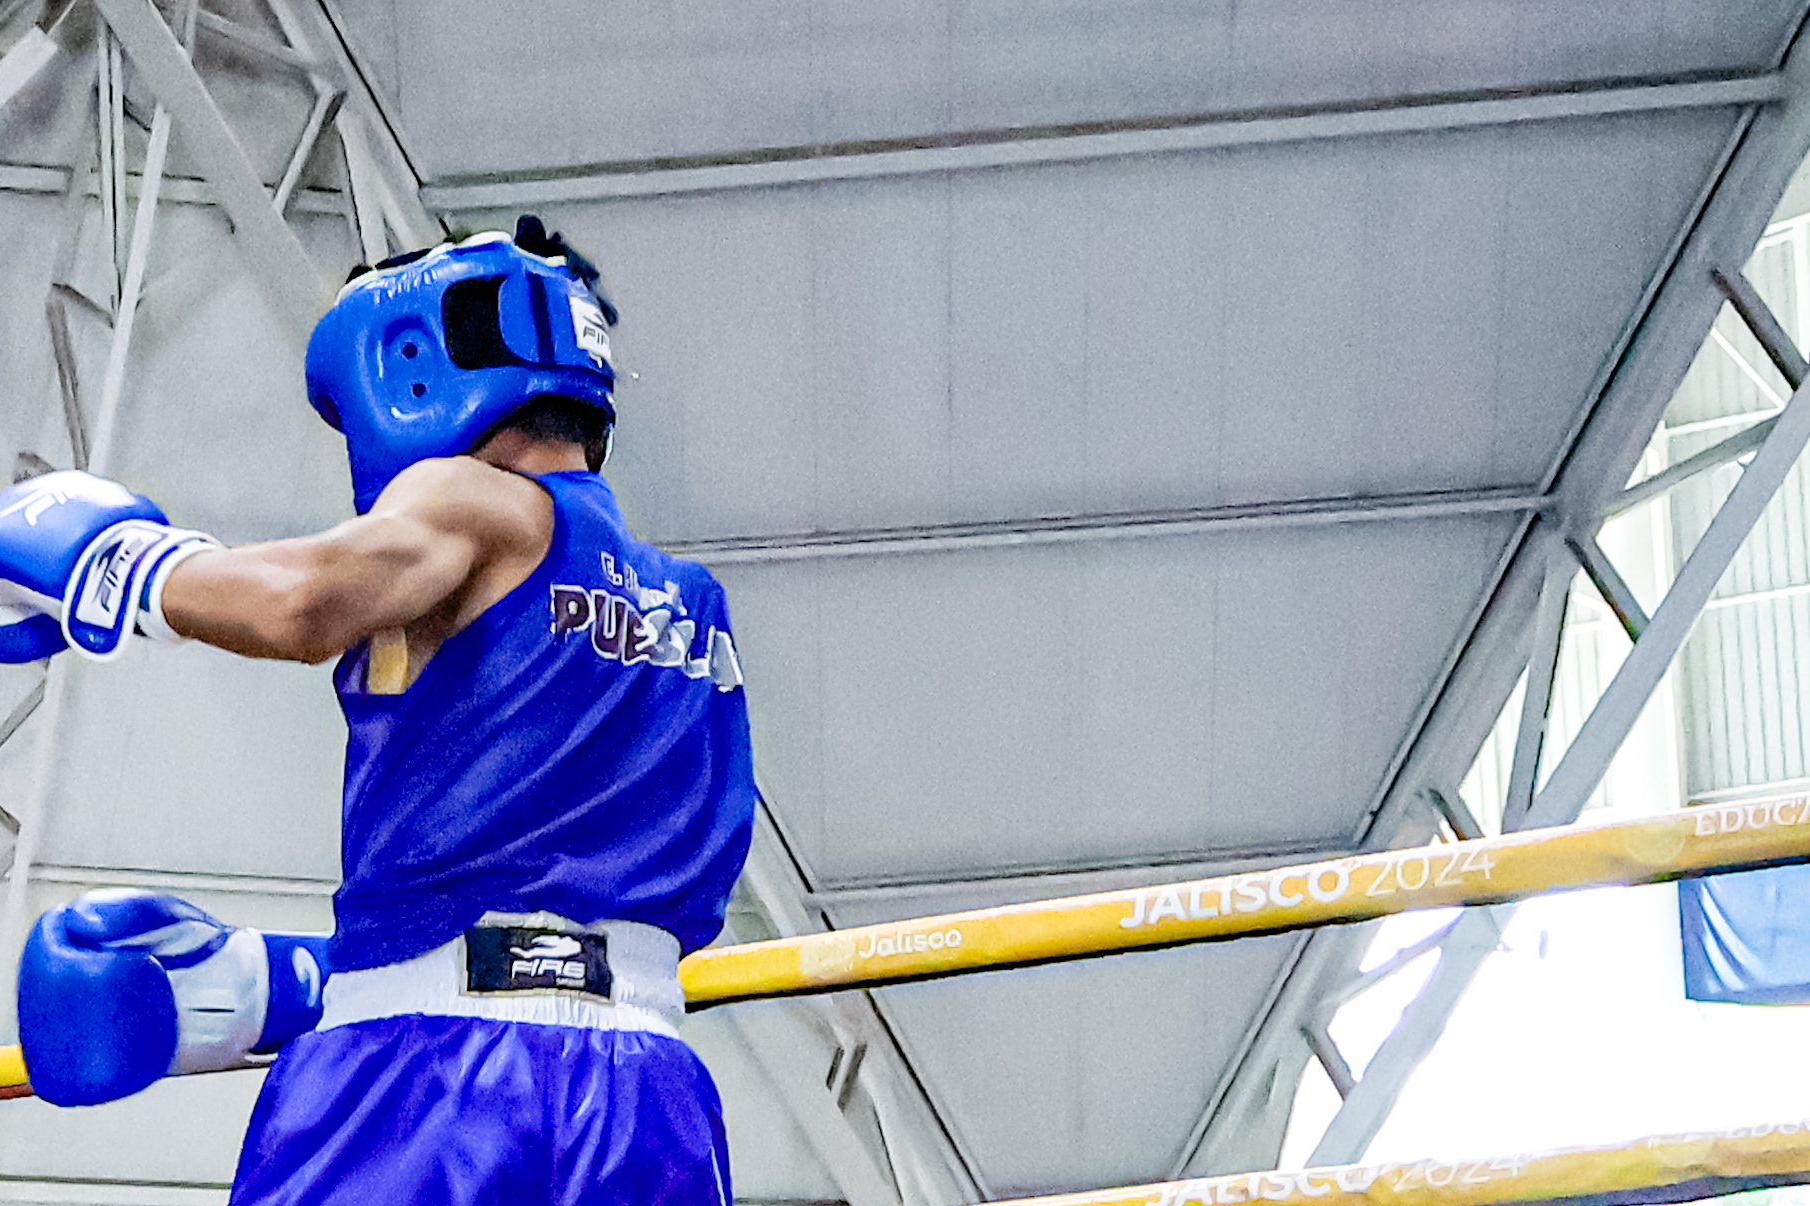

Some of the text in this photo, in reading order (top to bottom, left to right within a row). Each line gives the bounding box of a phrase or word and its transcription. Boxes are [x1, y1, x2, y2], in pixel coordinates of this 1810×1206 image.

[1120, 847, 1495, 929] JALISCO 2024
[858, 927, 963, 958] Jalisco
[1391, 1155, 1530, 1193] 2024
